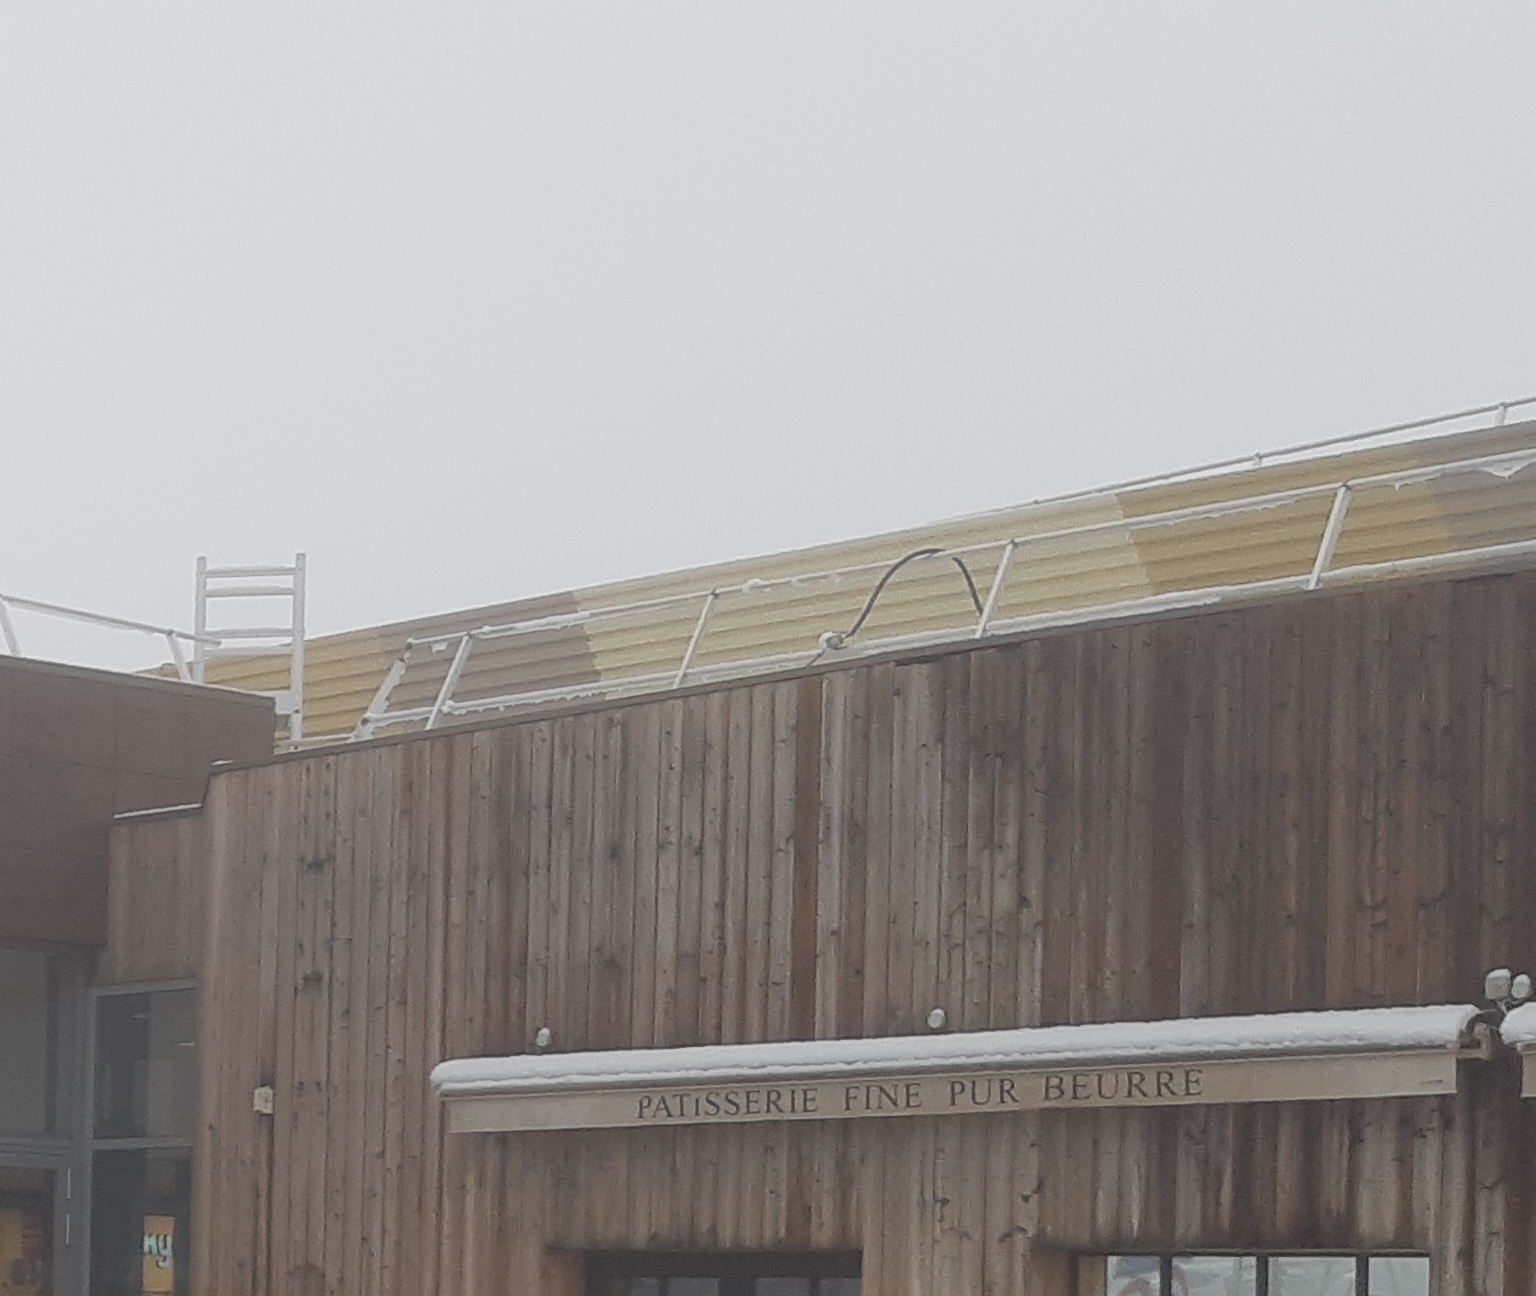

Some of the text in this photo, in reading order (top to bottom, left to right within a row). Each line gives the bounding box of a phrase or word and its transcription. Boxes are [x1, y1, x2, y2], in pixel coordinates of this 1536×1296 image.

[637, 1068, 1203, 1119] PATISSERIE FINE PUR BEURRE
